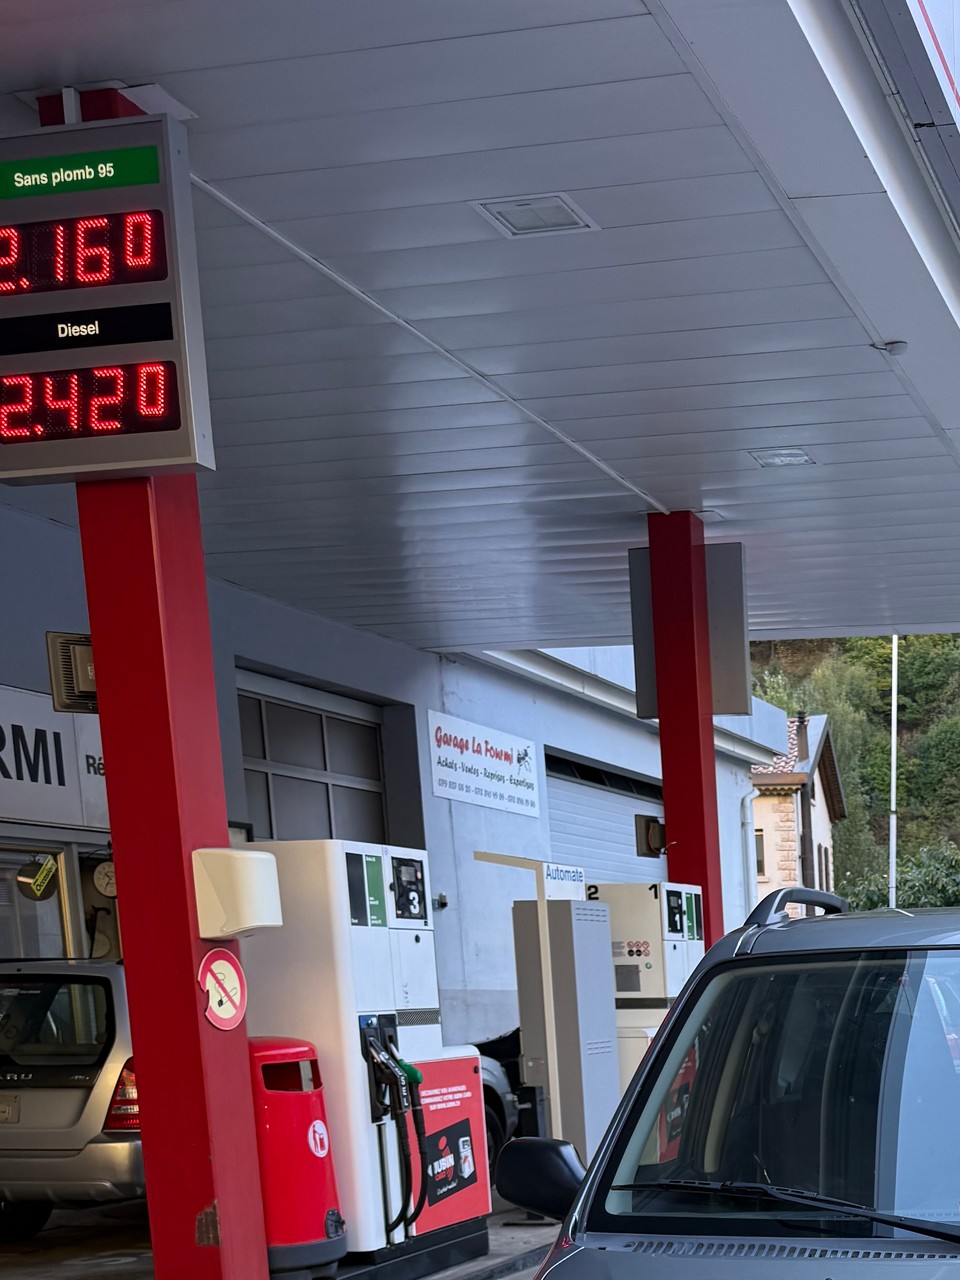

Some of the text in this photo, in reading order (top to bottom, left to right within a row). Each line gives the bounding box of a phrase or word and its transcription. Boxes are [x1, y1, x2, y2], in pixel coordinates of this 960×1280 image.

[14, 163, 115, 187] Sans plomb 95
[57, 320, 99, 338] Diesel
[435, 726, 469, 755] Garage
[471, 736, 482, 756] La
[546, 865, 583, 882] Automate
[588, 885, 599, 900] 2
[649, 884, 658, 899] 1
[408, 891, 420, 915] 3
[674, 913, 681, 930] 1
